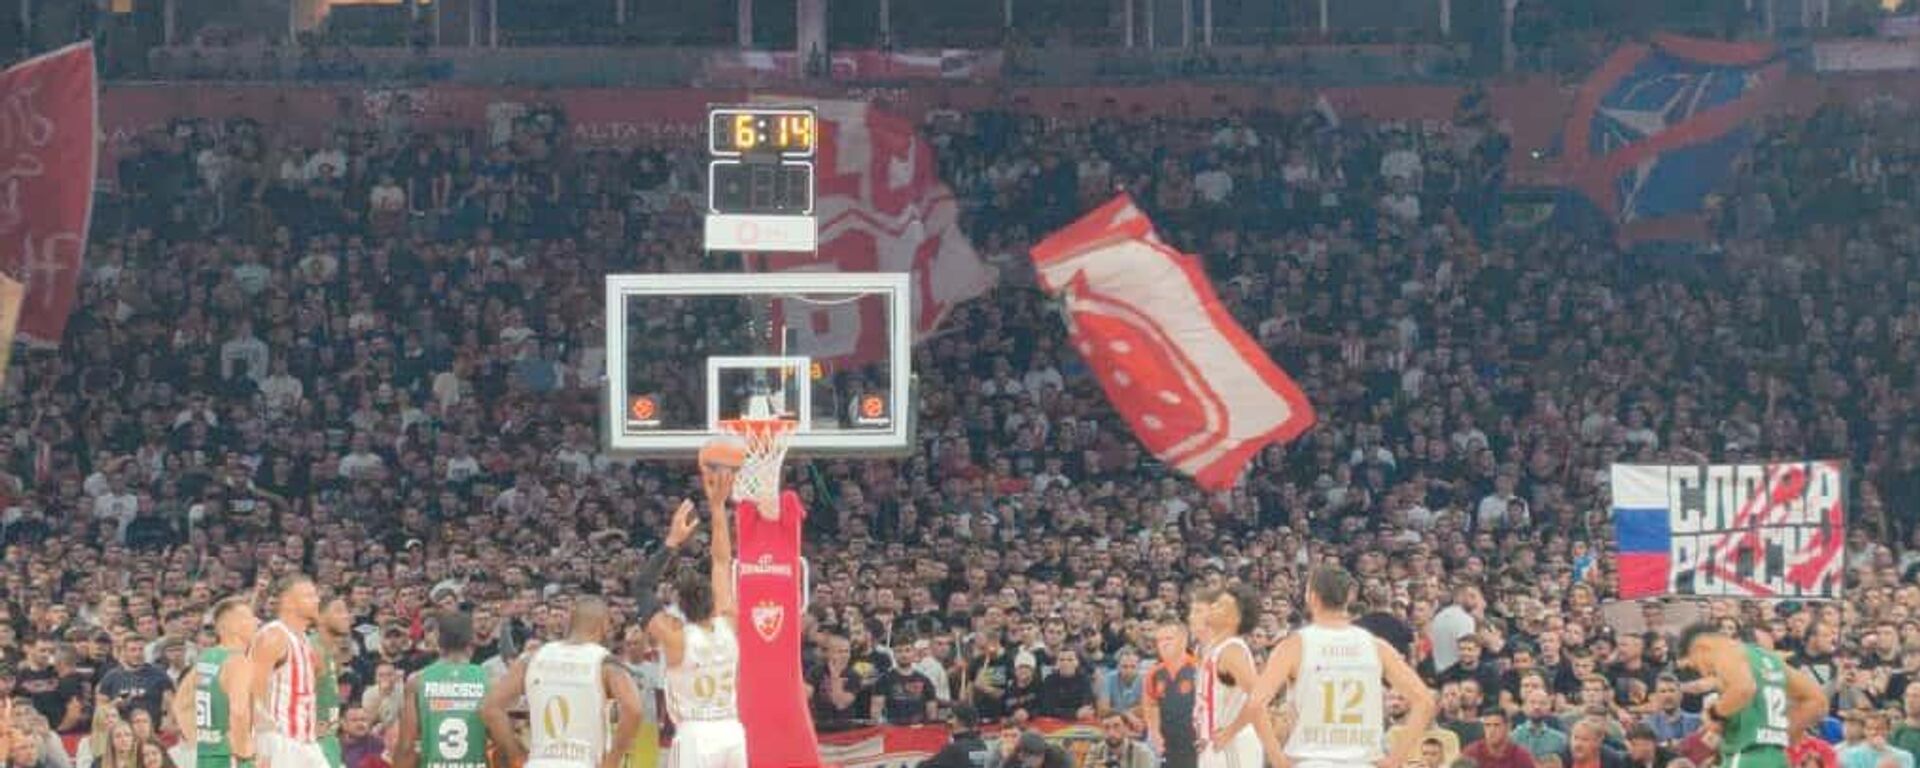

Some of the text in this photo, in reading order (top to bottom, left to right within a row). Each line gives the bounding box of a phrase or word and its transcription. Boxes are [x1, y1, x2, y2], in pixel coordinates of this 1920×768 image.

[735, 114, 811, 148] 6:14
[424, 682, 484, 698] FRANCISCO
[1321, 678, 1364, 724] 12
[1763, 686, 1787, 728] 12
[543, 694, 571, 740] 0
[438, 717, 469, 760] 3
